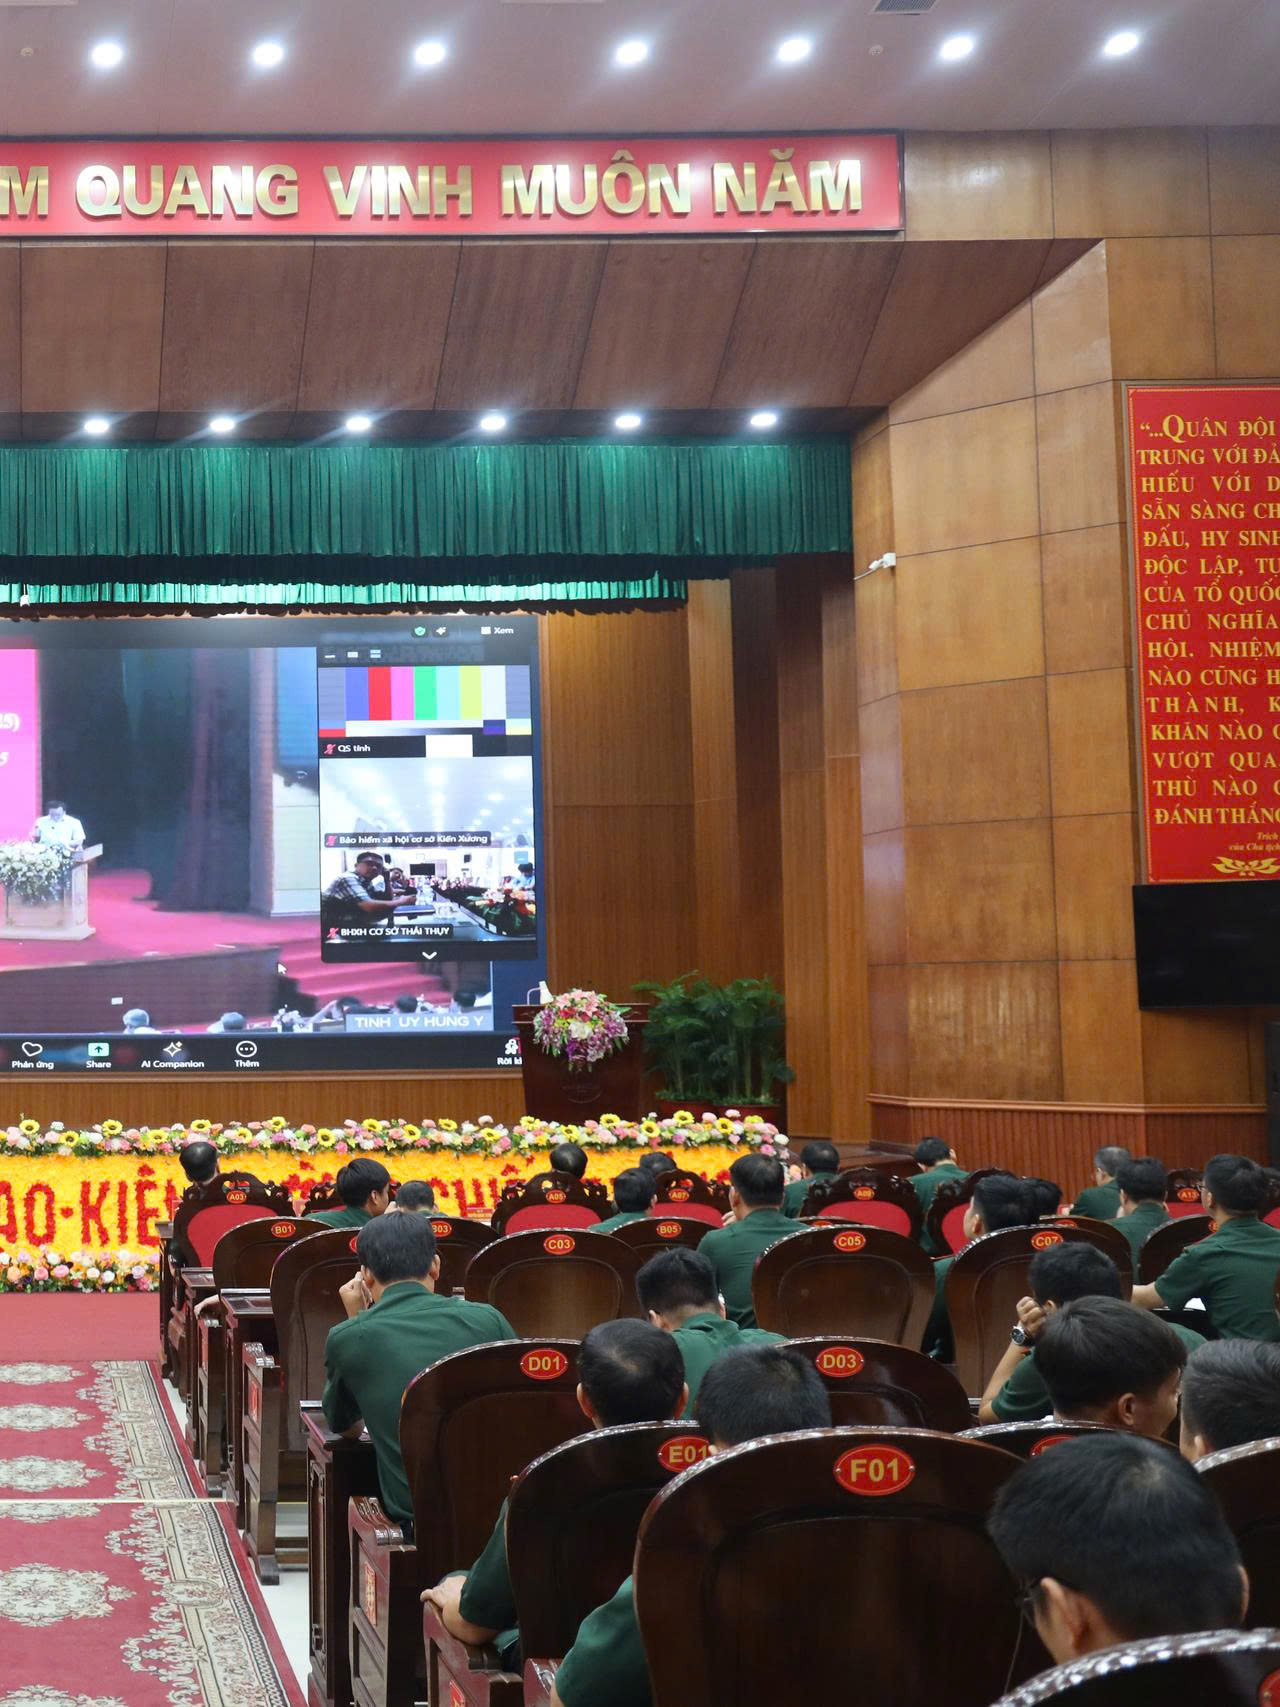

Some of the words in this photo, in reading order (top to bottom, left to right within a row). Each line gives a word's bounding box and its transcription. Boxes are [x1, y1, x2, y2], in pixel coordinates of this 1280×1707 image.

[76, 164, 299, 217] QUANG
[325, 165, 471, 216] VINH
[502, 151, 690, 216] MUÔN
[713, 148, 861, 213] NĂM
[1239, 417, 1275, 439] ĐỘI
[1136, 449, 1204, 464] TRUNG
[1212, 444, 1248, 464] VỚI
[1141, 470, 1194, 492] HIẾU
[1212, 471, 1251, 492] VỚI
[1142, 498, 1180, 519] SẴN
[1191, 499, 1245, 519] SÀNG
[1144, 524, 1190, 549] ĐẤU,
[1201, 531, 1229, 546] HY
[341, 928, 366, 936] BHXH
[86, 1060, 111, 1068] Share
[153, 1060, 205, 1069] Companion
[234, 1059, 259, 1067] Thêm
[80, 1163, 177, 1247] KIÊ
[230, 1193, 245, 1201] A03
[274, 1225, 293, 1234] B01
[659, 1225, 678, 1234] B05
[548, 1239, 571, 1250] C03
[838, 1235, 862, 1248] C05
[527, 1355, 562, 1371] D01
[823, 1354, 858, 1370] D03
[669, 1445, 707, 1463] E01
[849, 1457, 902, 1484] F01
